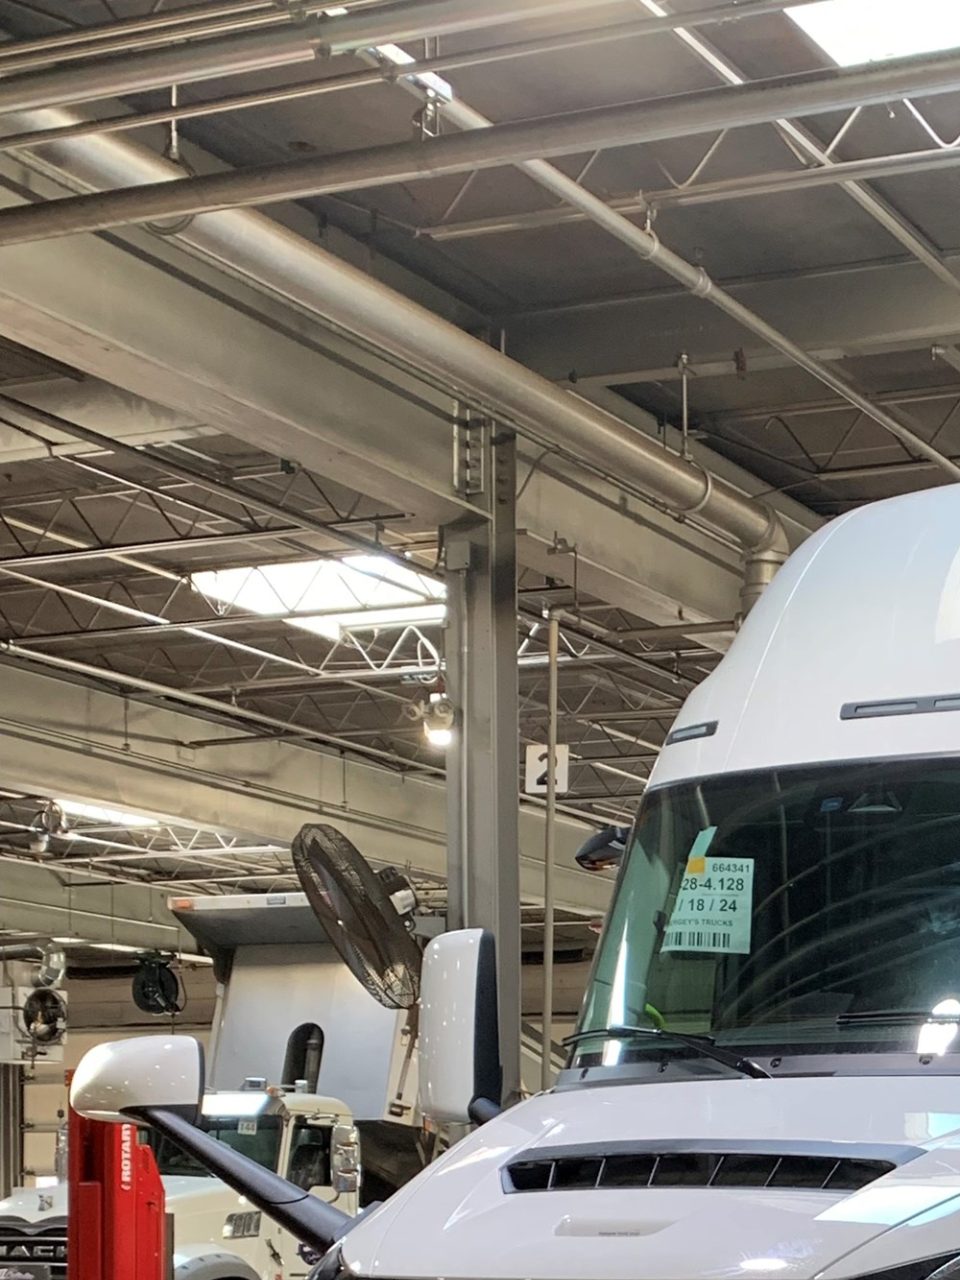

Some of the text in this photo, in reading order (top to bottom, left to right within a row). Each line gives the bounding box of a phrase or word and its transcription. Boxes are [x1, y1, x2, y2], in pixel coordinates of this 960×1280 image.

[536, 752, 558, 785] 2
[712, 863, 750, 873] 664341
[688, 898, 705, 911] 18
[719, 898, 738, 912] 24
